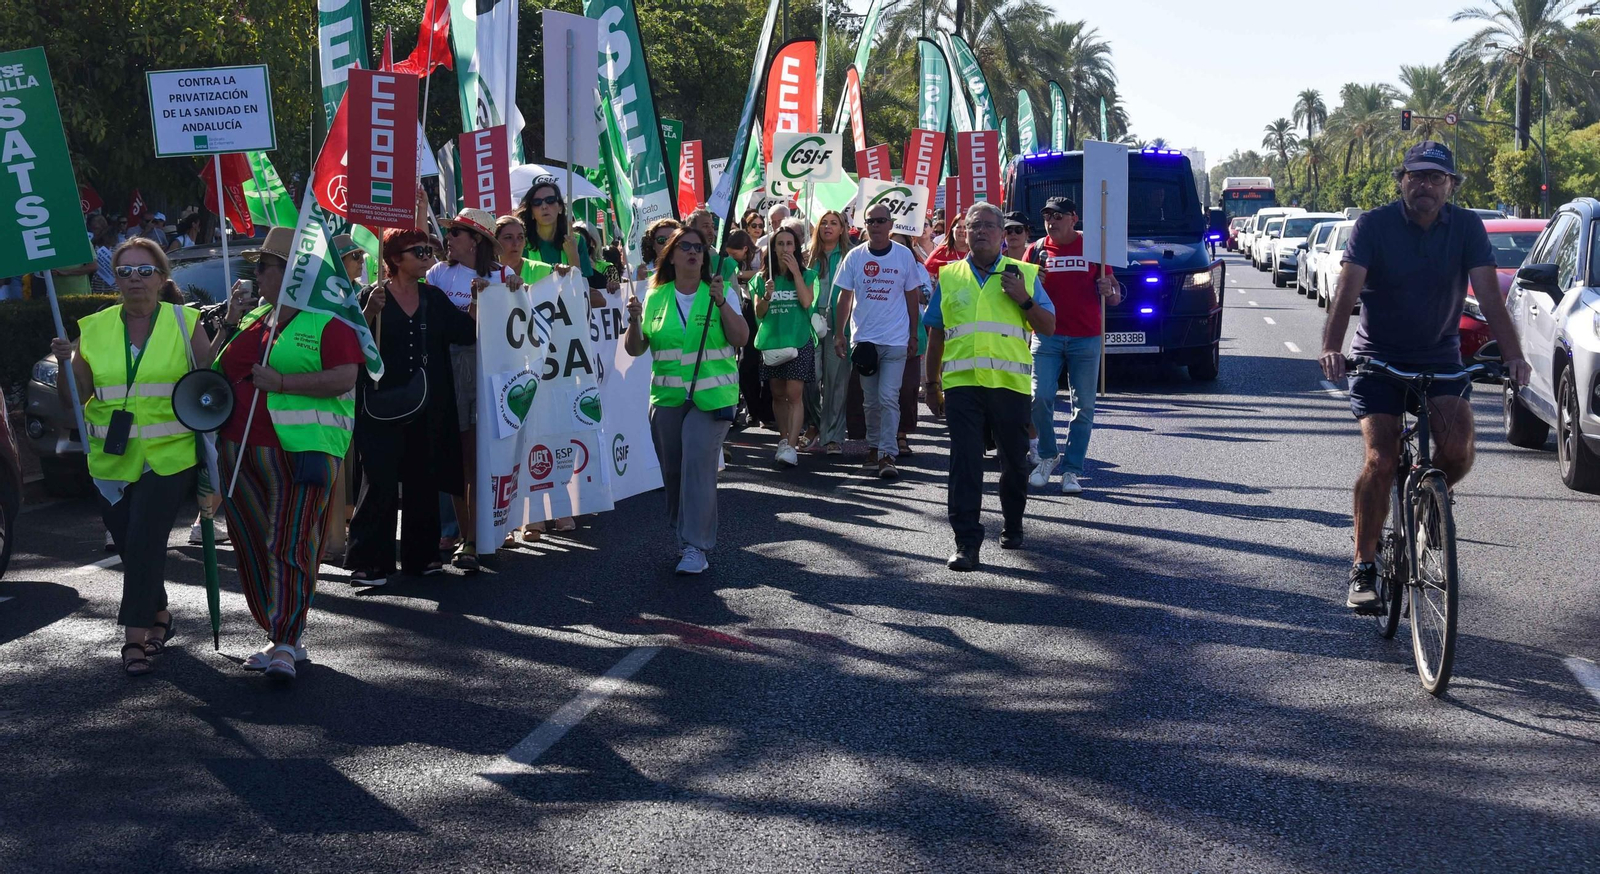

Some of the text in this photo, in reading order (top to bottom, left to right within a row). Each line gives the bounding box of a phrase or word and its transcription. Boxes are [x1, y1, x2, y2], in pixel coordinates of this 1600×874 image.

[178, 75, 236, 87] CONTRA LA
[169, 88, 248, 103] PRIVATIZACIÓN
[163, 104, 258, 118] DE LA SANIDAD EN
[182, 119, 242, 132] ANDALUCÍA
[370, 75, 396, 179] CCOO
[970, 132, 988, 192] CCOO
[475, 131, 497, 212] CCOO
[895, 223, 916, 232] SEVILLA
[1105, 333, 1144, 343] P3833BB
[296, 342, 319, 351] SEVILLA
[531, 449, 549, 466] UGT
